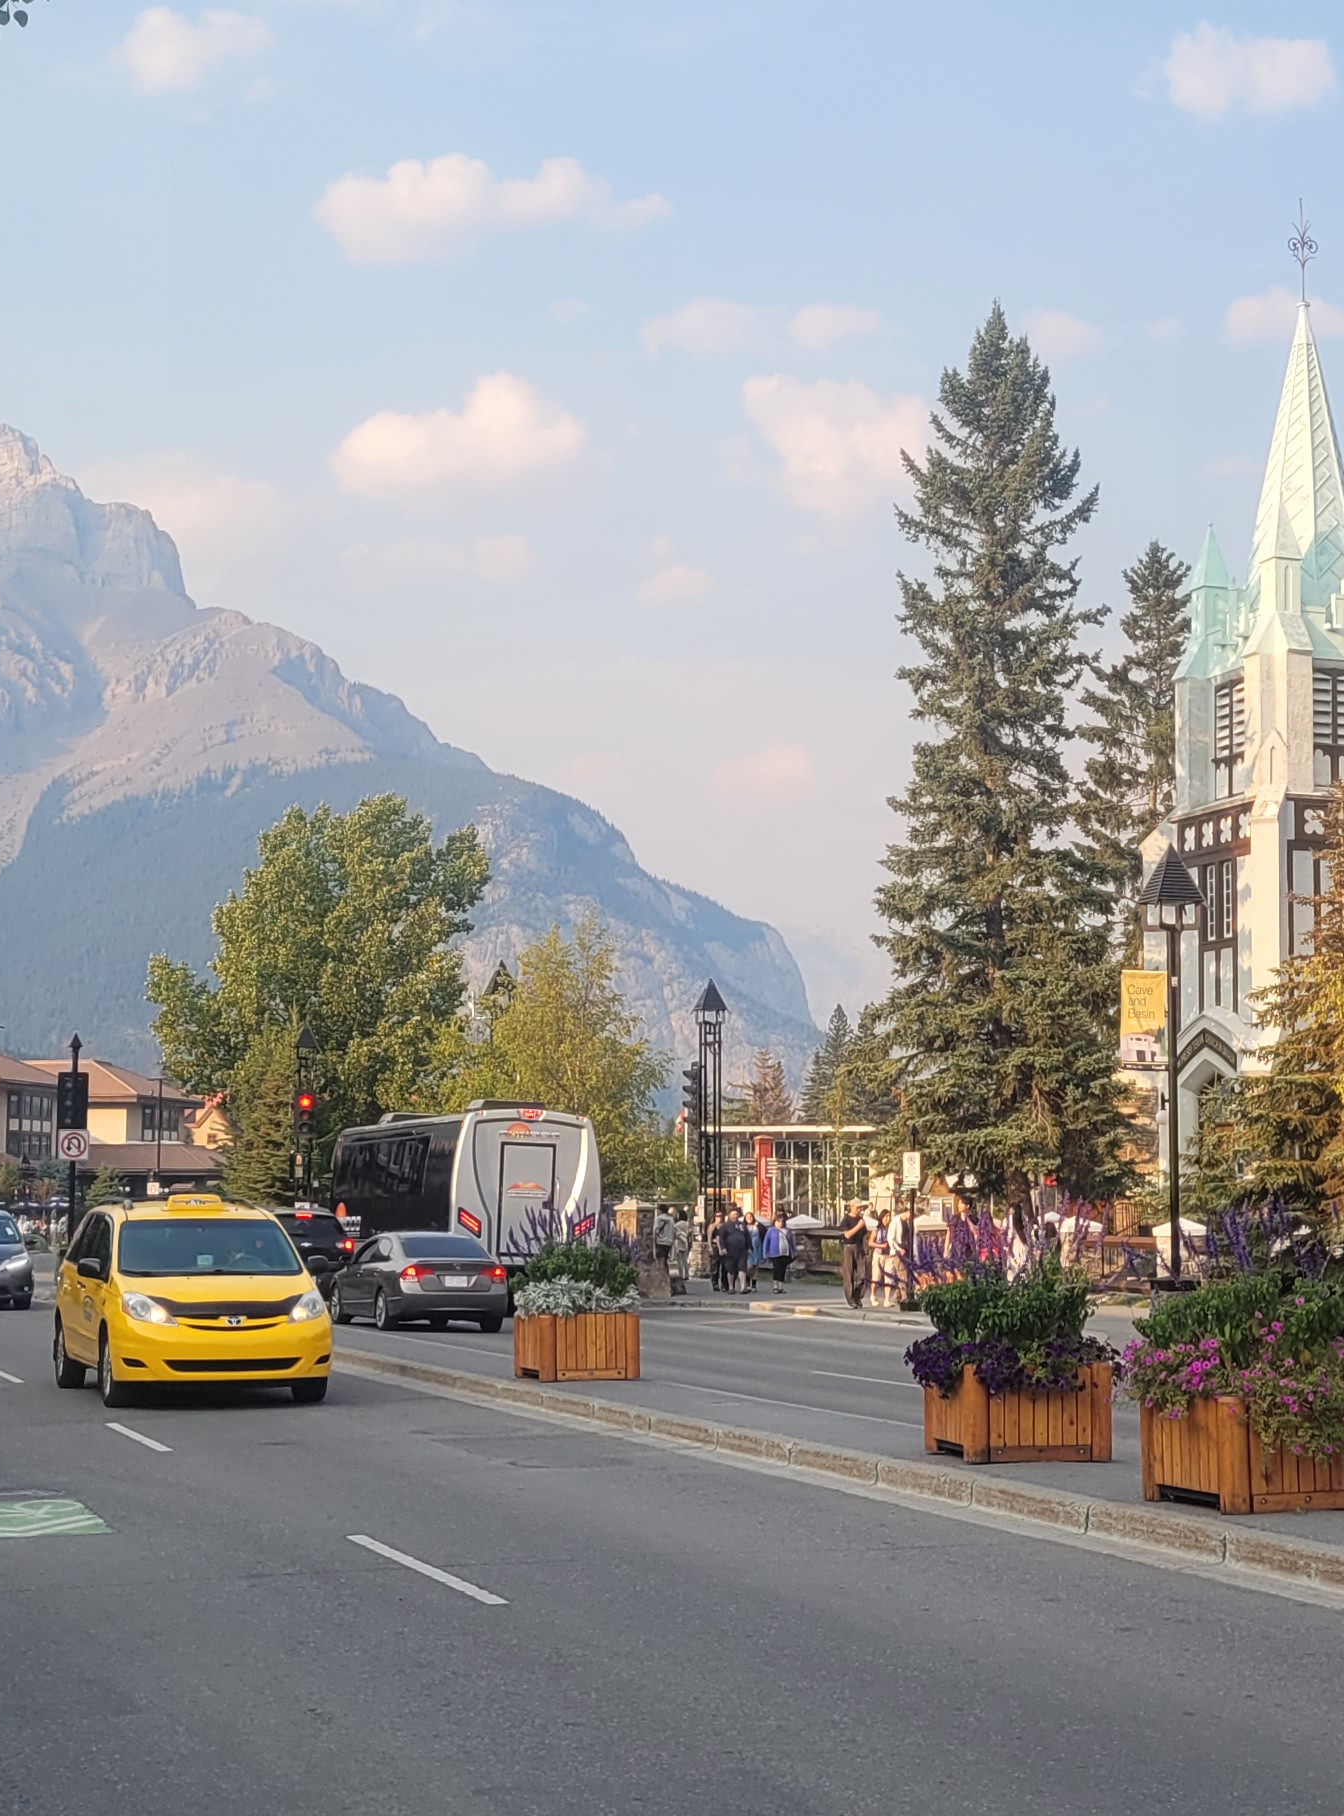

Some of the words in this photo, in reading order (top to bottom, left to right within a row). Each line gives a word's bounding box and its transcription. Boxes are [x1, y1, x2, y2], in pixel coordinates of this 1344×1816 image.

[1127, 984, 1154, 996] Cave
[1128, 996, 1147, 1006] and
[1127, 1008, 1155, 1020] Basin
